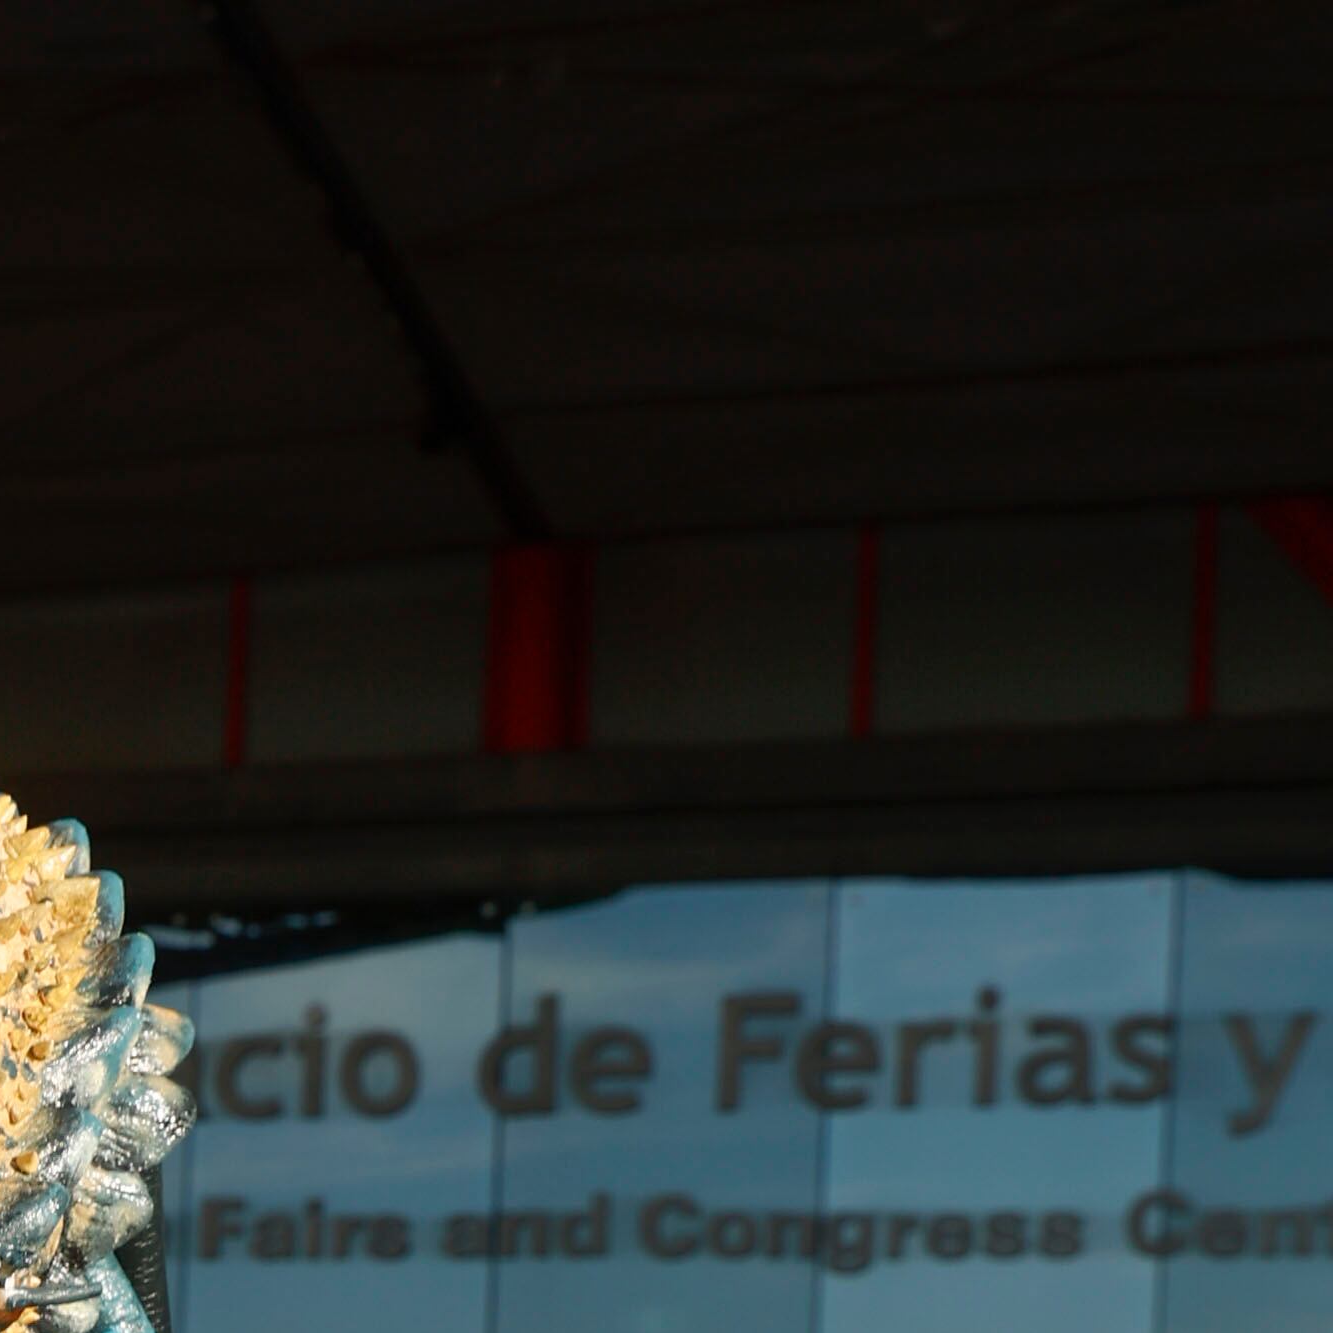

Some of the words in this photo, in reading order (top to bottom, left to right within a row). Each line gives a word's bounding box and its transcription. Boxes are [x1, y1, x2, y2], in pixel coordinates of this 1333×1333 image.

[176, 1003, 421, 1121] cio
[477, 989, 653, 1118] de
[713, 983, 1177, 1115] Ferias
[1221, 1007, 1318, 1137] y
[196, 1195, 412, 1262] Fairs
[441, 1190, 612, 1261] and
[638, 1192, 1084, 1275] Congress
